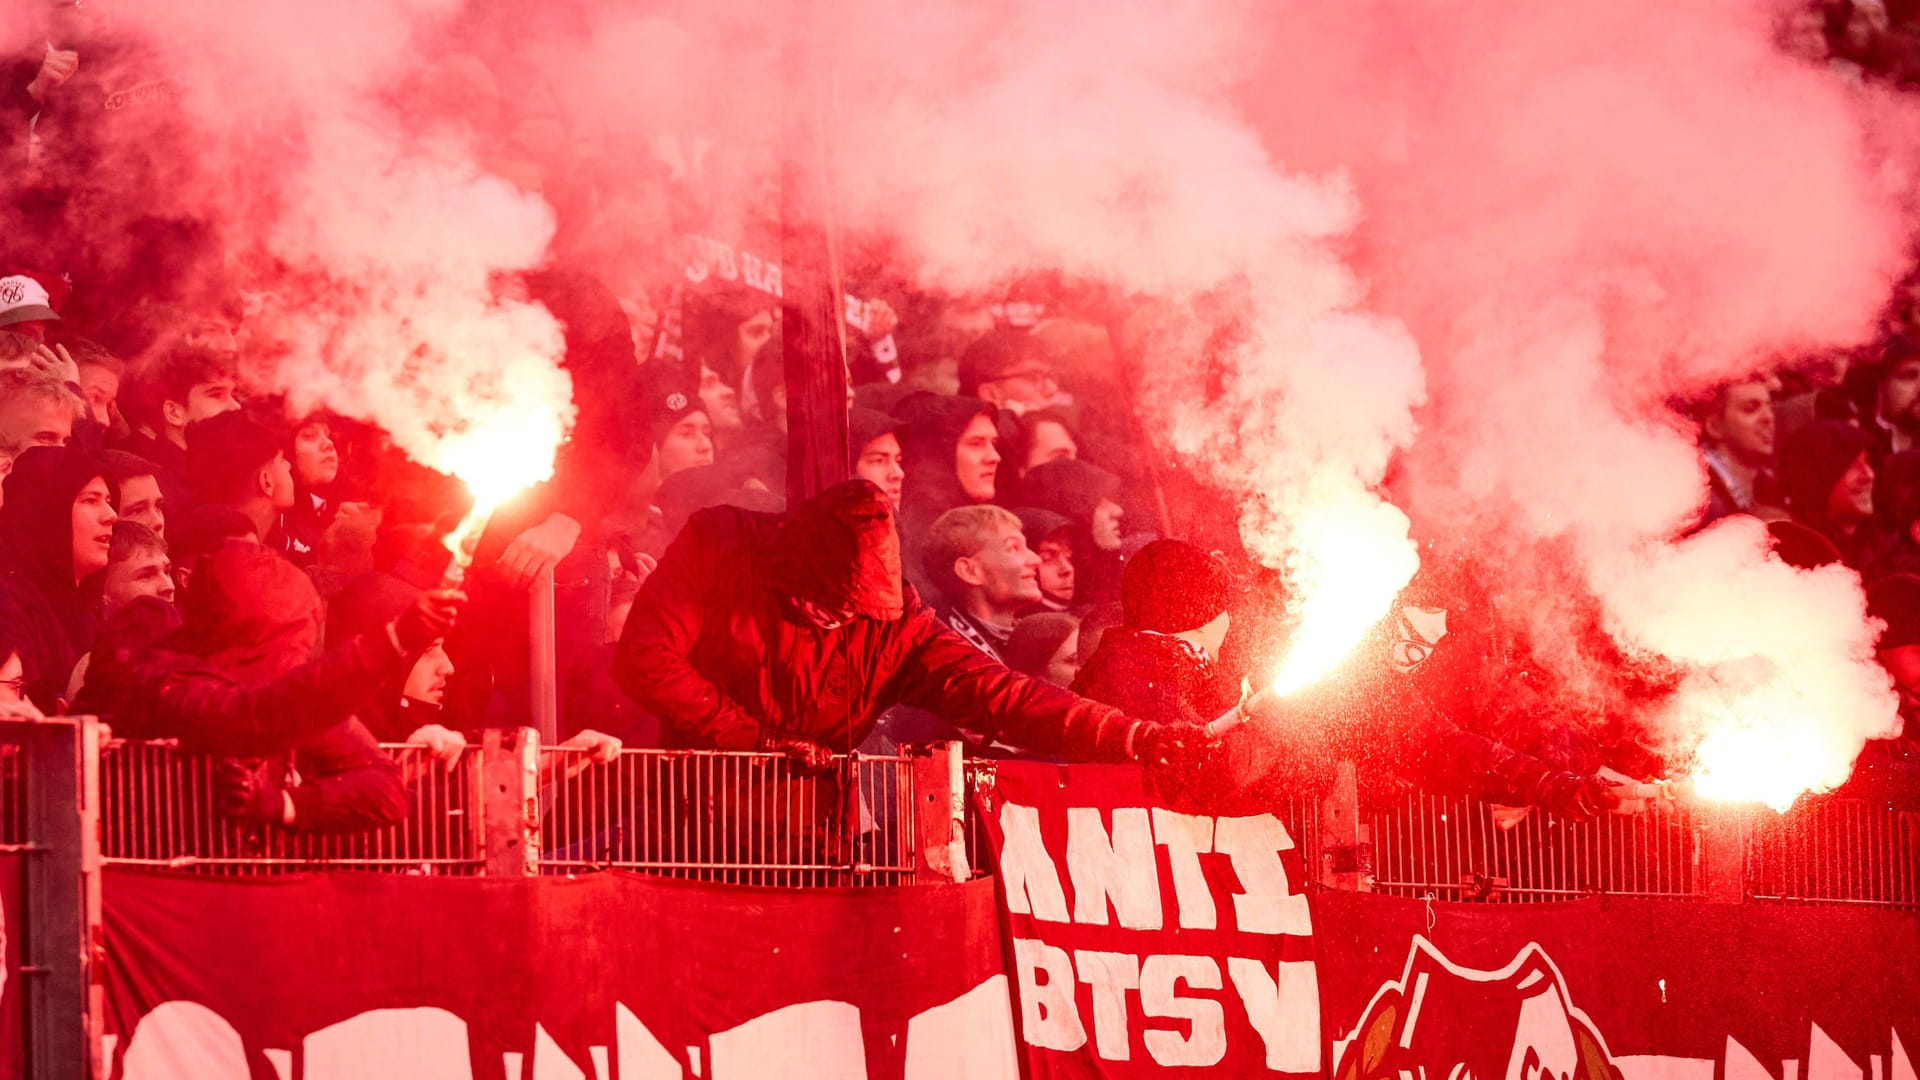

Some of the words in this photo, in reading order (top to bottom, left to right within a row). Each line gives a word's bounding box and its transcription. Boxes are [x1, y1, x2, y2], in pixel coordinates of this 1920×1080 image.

[2, 286, 24, 304] 96
[999, 800, 1313, 936] ANTI
[1013, 936, 1321, 1073] BTSY
